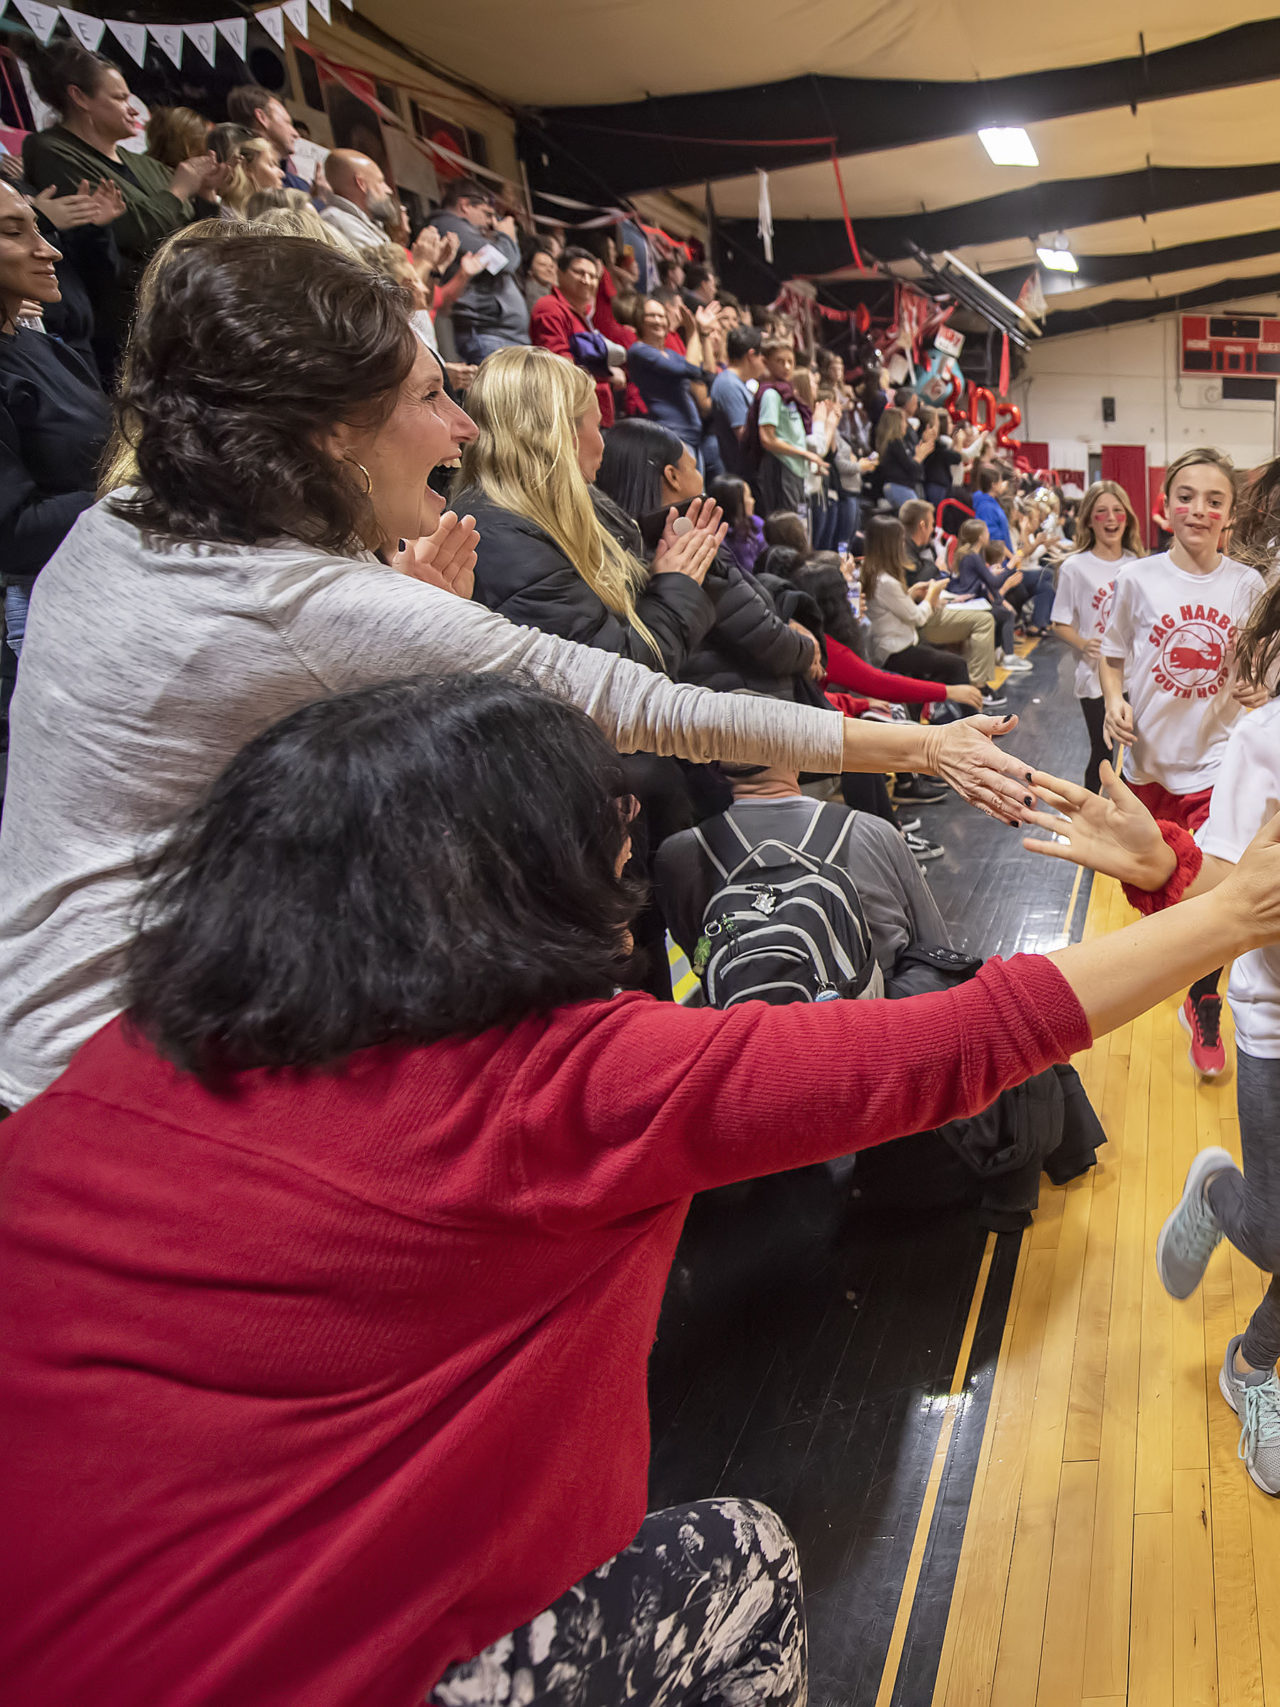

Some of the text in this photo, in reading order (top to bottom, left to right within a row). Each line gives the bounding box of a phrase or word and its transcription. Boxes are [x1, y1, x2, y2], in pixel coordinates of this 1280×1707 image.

[1091, 587, 1107, 610] SAG
[1149, 614, 1175, 647] SAG
[1152, 664, 1192, 699] YOUTH
